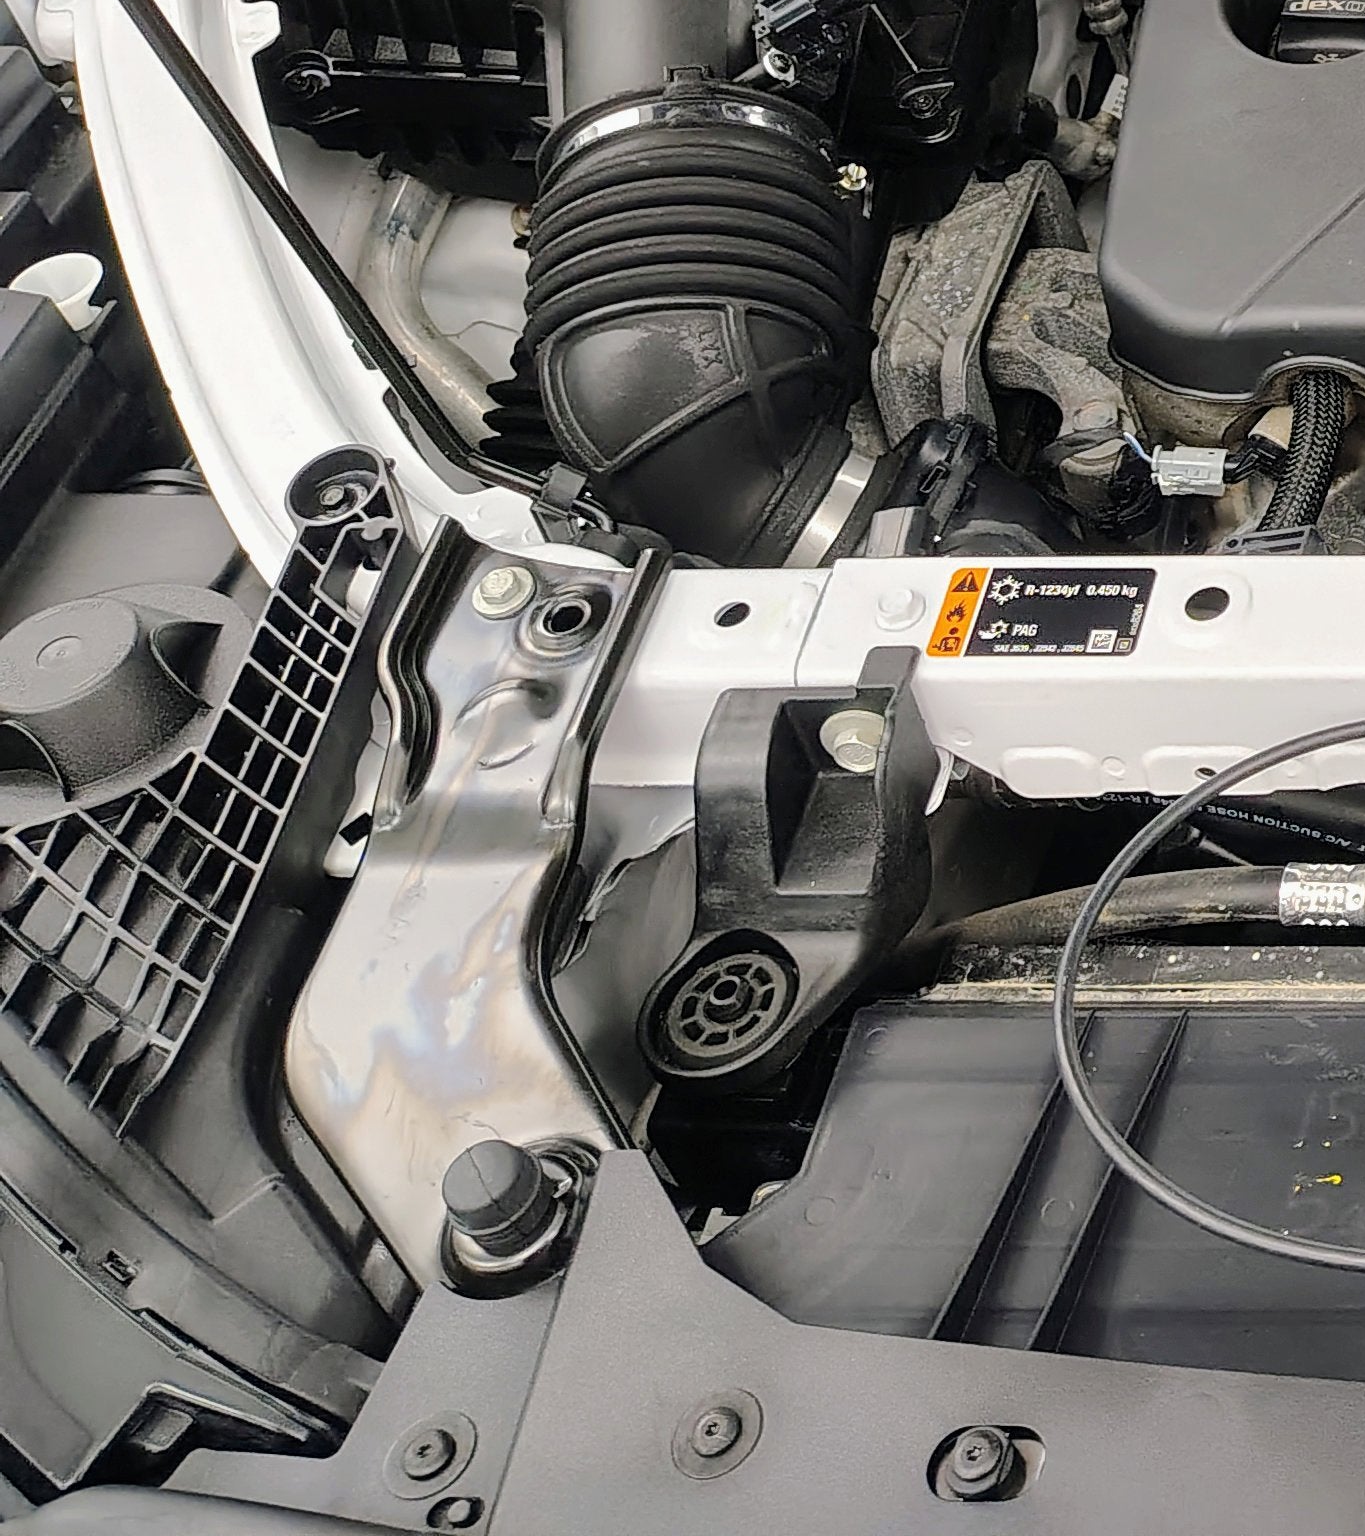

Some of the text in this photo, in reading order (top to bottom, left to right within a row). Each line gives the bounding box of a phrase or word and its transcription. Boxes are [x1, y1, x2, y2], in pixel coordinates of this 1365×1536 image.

[1024, 585, 1138, 598] R-1234yf 0.450 kg
[1011, 624, 1038, 636] PAG
[1205, 804, 1250, 820] HOSE
[1252, 813, 1322, 839] SUCTION
[1323, 833, 1352, 848] A/C
